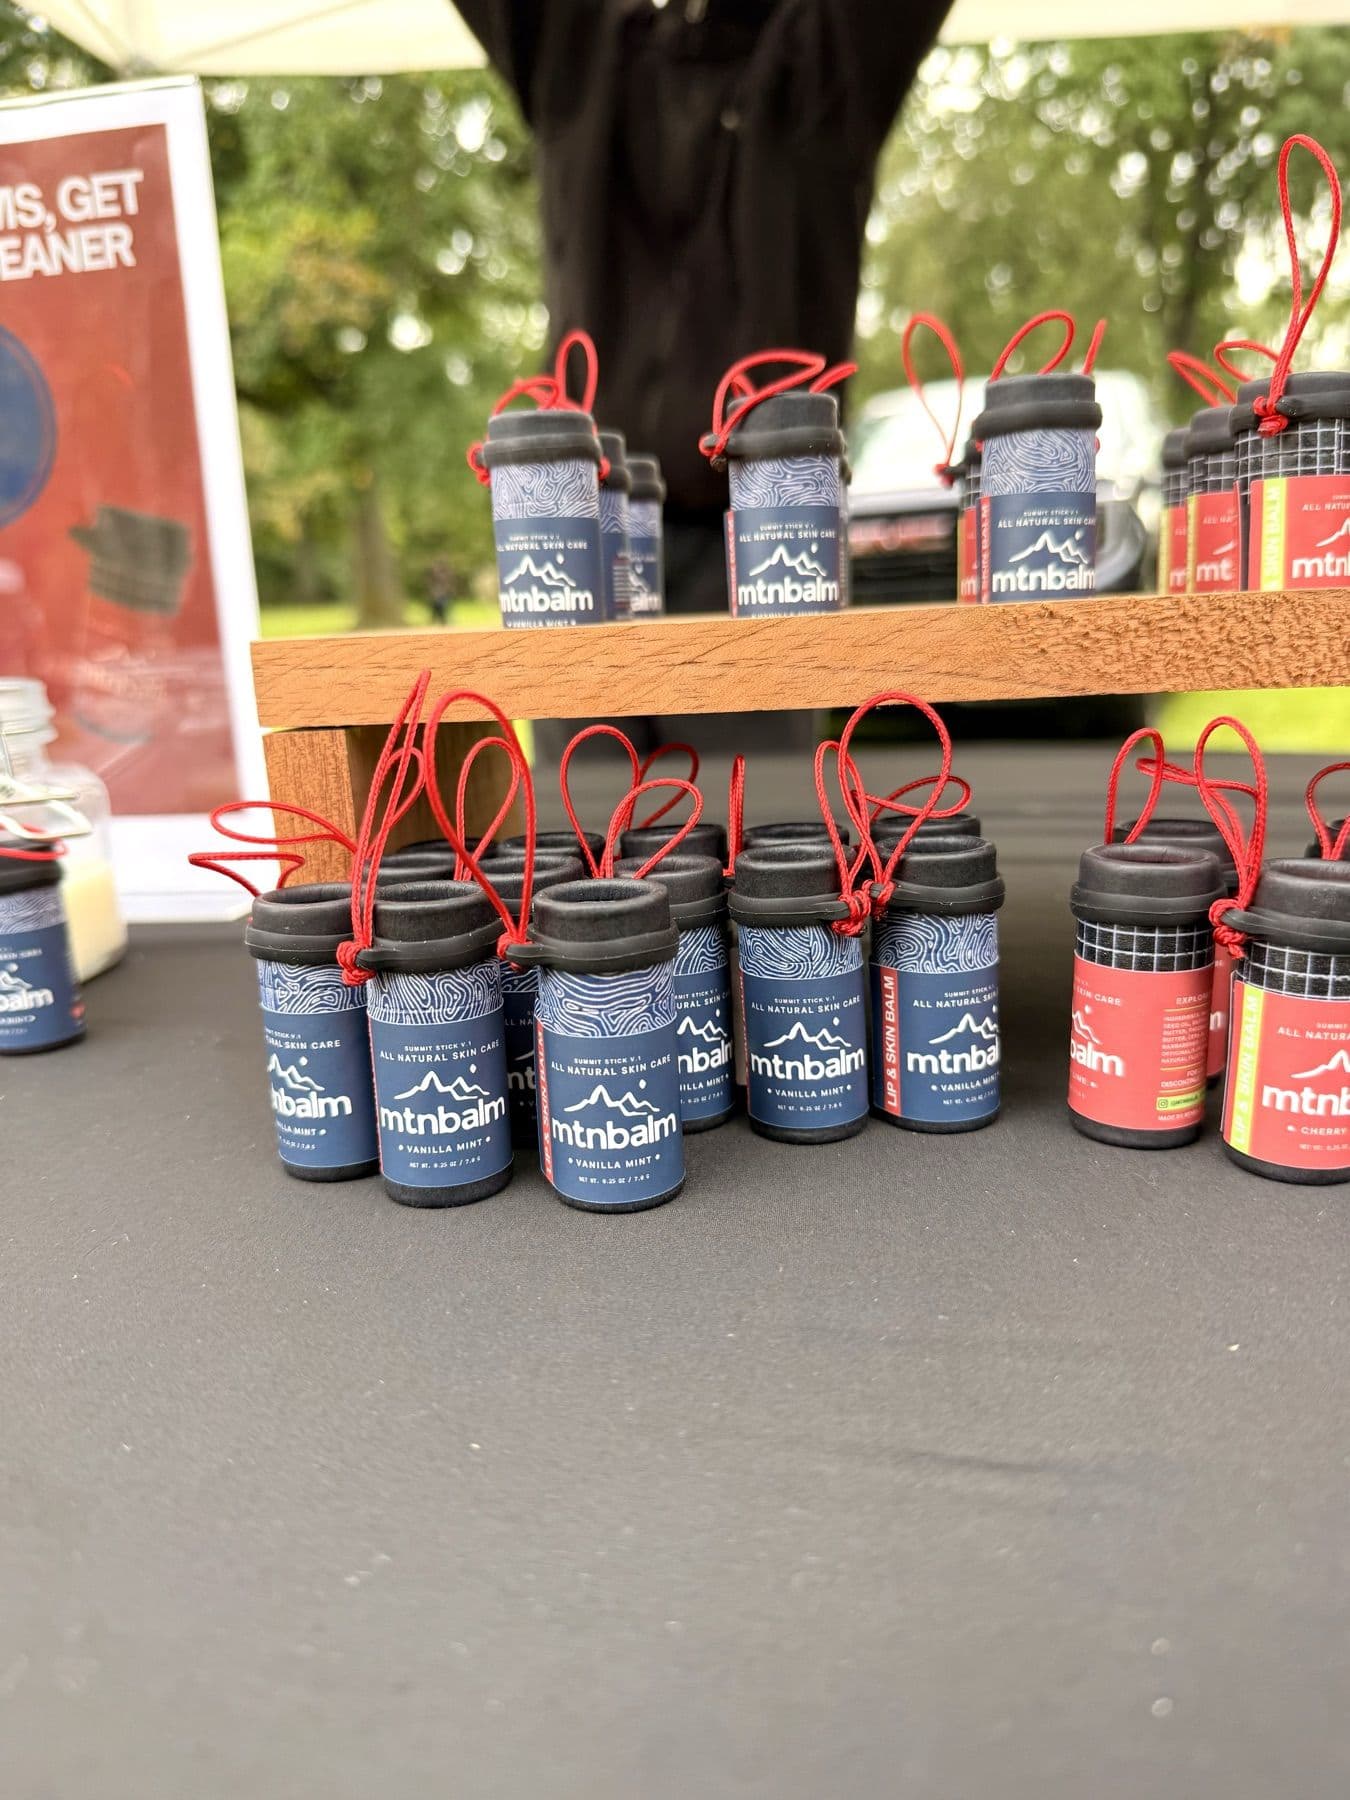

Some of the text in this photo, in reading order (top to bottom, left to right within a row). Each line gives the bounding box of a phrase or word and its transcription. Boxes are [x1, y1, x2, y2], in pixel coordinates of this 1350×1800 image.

[57, 169, 144, 222] GET
[998, 519, 1013, 529] ALL
[1016, 518, 1060, 527] NATURAL
[1063, 518, 1081, 526] SKIN
[754, 531, 795, 541] NATURAL
[798, 530, 818, 539] SKIN
[820, 530, 836, 539] CARE
[543, 541, 565, 550] SKIN
[567, 541, 588, 550] CARE
[1292, 551, 1350, 579] mtn
[992, 562, 1096, 593] mtnbalm
[738, 576, 839, 606] mtnbalm
[704, 994, 721, 1006] SKIN
[944, 990, 969, 998] SUMMIT
[1094, 993, 1122, 1006] CARE
[751, 994, 860, 1014] ALL NATURAL SKIN CARE
[913, 1000, 933, 1008] ALL
[936, 996, 982, 1008] NATURAL
[1277, 1026, 1301, 1038] ALL
[284, 1040, 307, 1050] SKIN
[311, 1039, 341, 1050] CARE
[436, 1043, 458, 1051] STICK
[884, 976, 897, 1107] LIP & SKIN BALM
[380, 1039, 499, 1063] ALL NATURAL SKIN CARE
[551, 1054, 671, 1076] ALL NATURAL SKIN CARE
[574, 1057, 601, 1065] SUMMIT
[604, 1056, 627, 1064] STICK
[751, 1048, 864, 1080] mtnbalm
[707, 1074, 724, 1087] MINT
[941, 1080, 981, 1091] VANILLA
[775, 1085, 844, 1098] VANILLA MINT
[541, 1087, 549, 1126] SKIN
[380, 1096, 505, 1135] mtnbalm
[293, 1126, 317, 1136] MINT
[551, 1112, 677, 1150] mtnbalm
[1300, 1126, 1347, 1136] CHERRY
[406, 1138, 482, 1154] VANILLA MINT
[576, 1155, 652, 1169] VANILLA MINT
